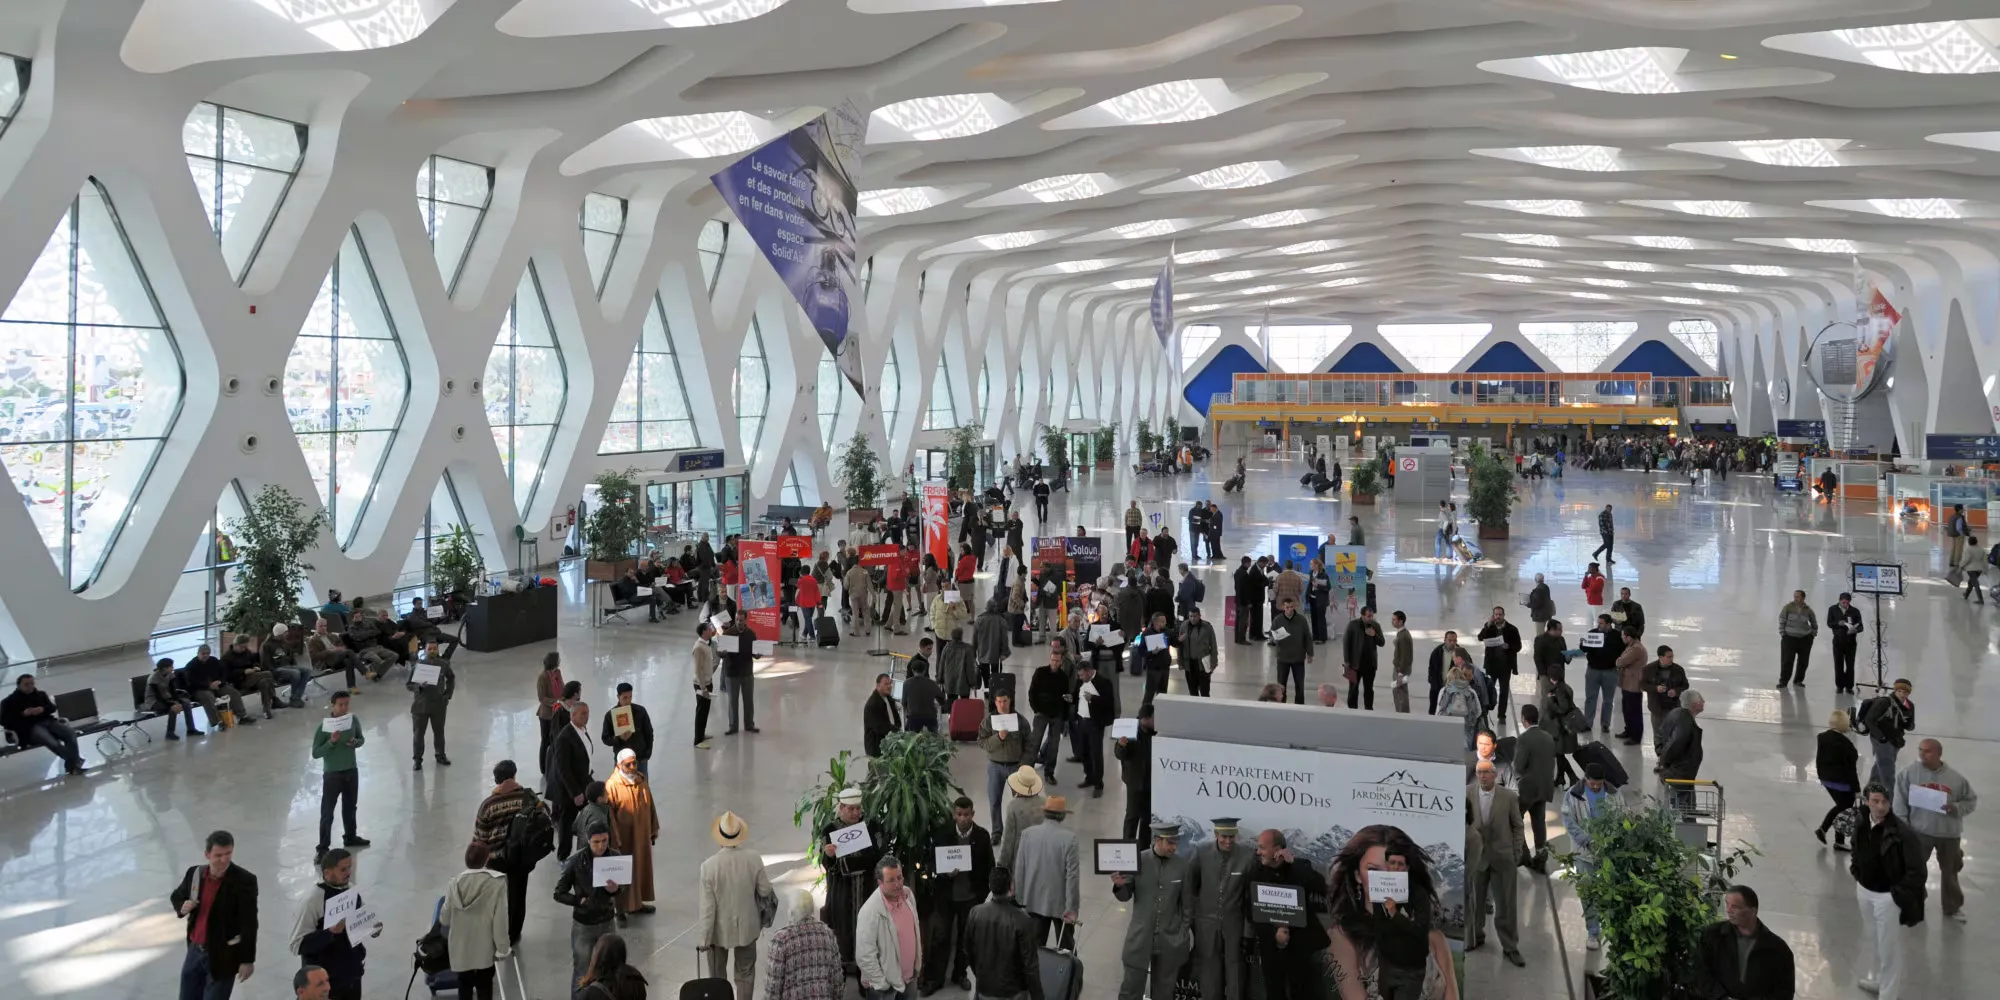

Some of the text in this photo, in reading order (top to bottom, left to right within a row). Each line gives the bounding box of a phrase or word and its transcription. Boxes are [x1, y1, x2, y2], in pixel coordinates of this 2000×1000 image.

[751, 156, 806, 190] Le savoir faire
[747, 177, 805, 209] et des produits
[739, 194, 805, 226] en fer dans votre
[777, 228, 805, 245] espace
[923, 486, 947, 495] FRAM
[1160, 758, 1315, 784] VOTRE APPARTEMENT
[1196, 777, 1211, 797] À
[1216, 780, 1296, 805] 100.000
[1352, 789, 1391, 800] JARDINS
[1390, 788, 1454, 812] ATLAS
